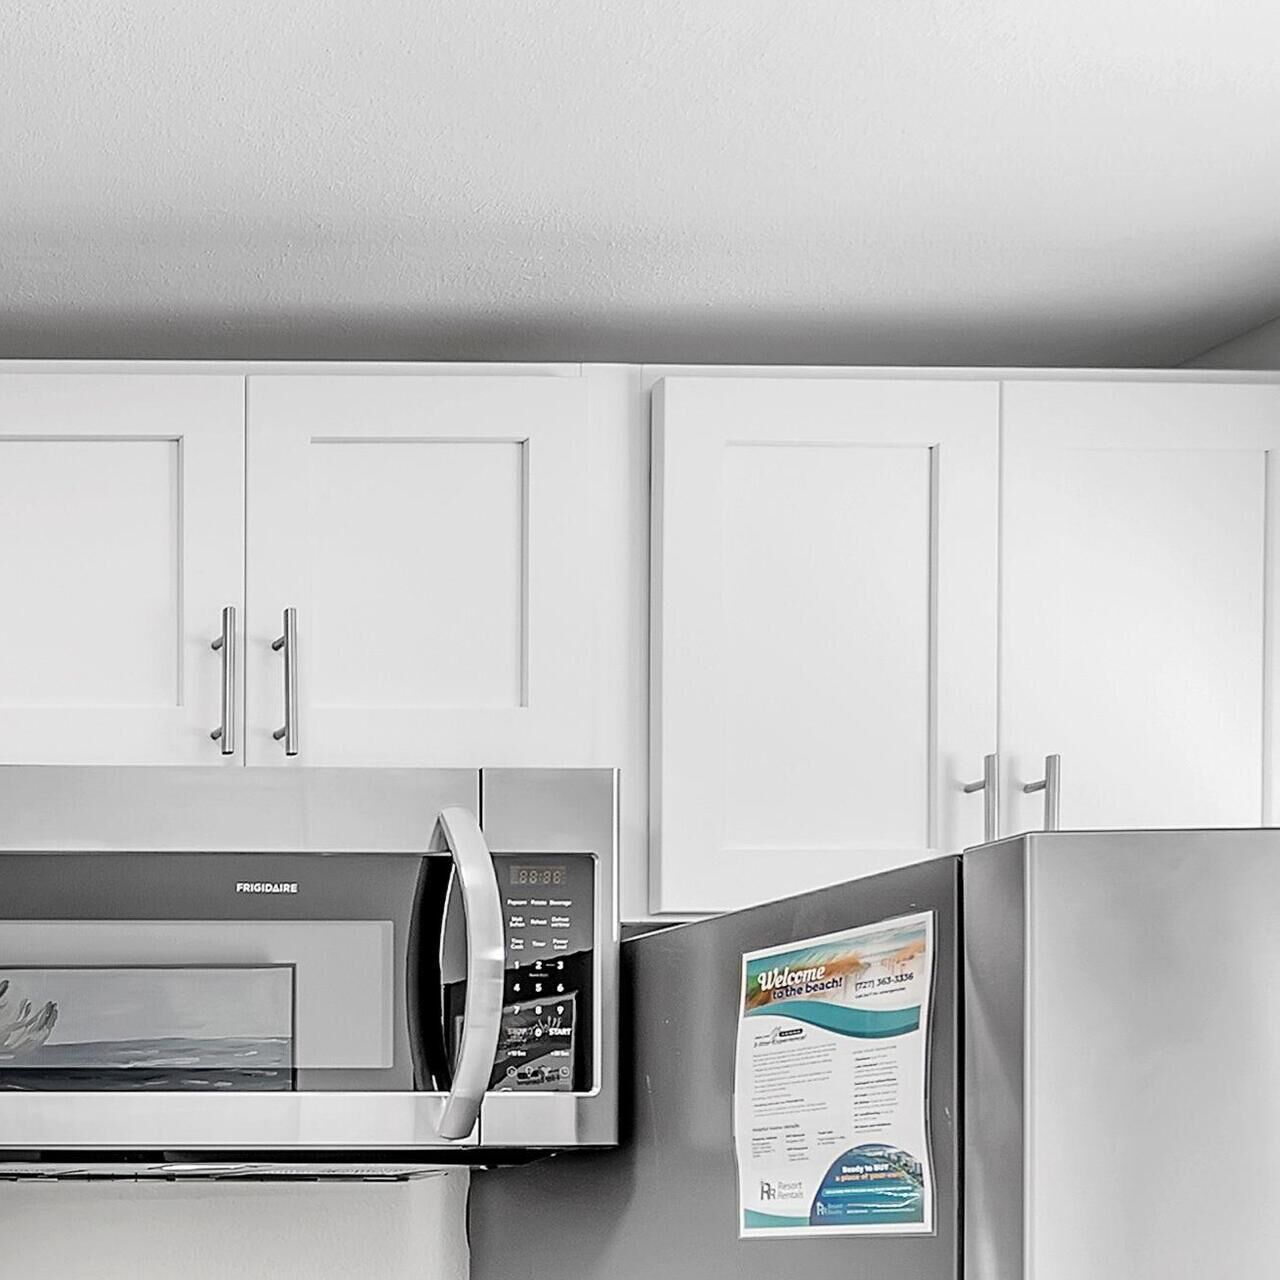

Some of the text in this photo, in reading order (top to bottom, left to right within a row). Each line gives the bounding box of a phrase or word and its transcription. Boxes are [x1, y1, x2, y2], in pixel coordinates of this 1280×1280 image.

[236, 883, 298, 893] FRIGIDAIRE
[514, 960, 520, 970] 1
[535, 960, 543, 970] 2
[557, 960, 564, 970] 3
[757, 966, 826, 992] Welcome
[513, 983, 521, 992] 4
[535, 983, 542, 992] 5
[557, 983, 565, 992] 6
[773, 990, 784, 999] to
[785, 986, 803, 997] the
[805, 977, 843, 993] beach!
[513, 1005, 521, 1015] 7
[535, 1005, 542, 1015] 8
[557, 1005, 565, 1015] 9
